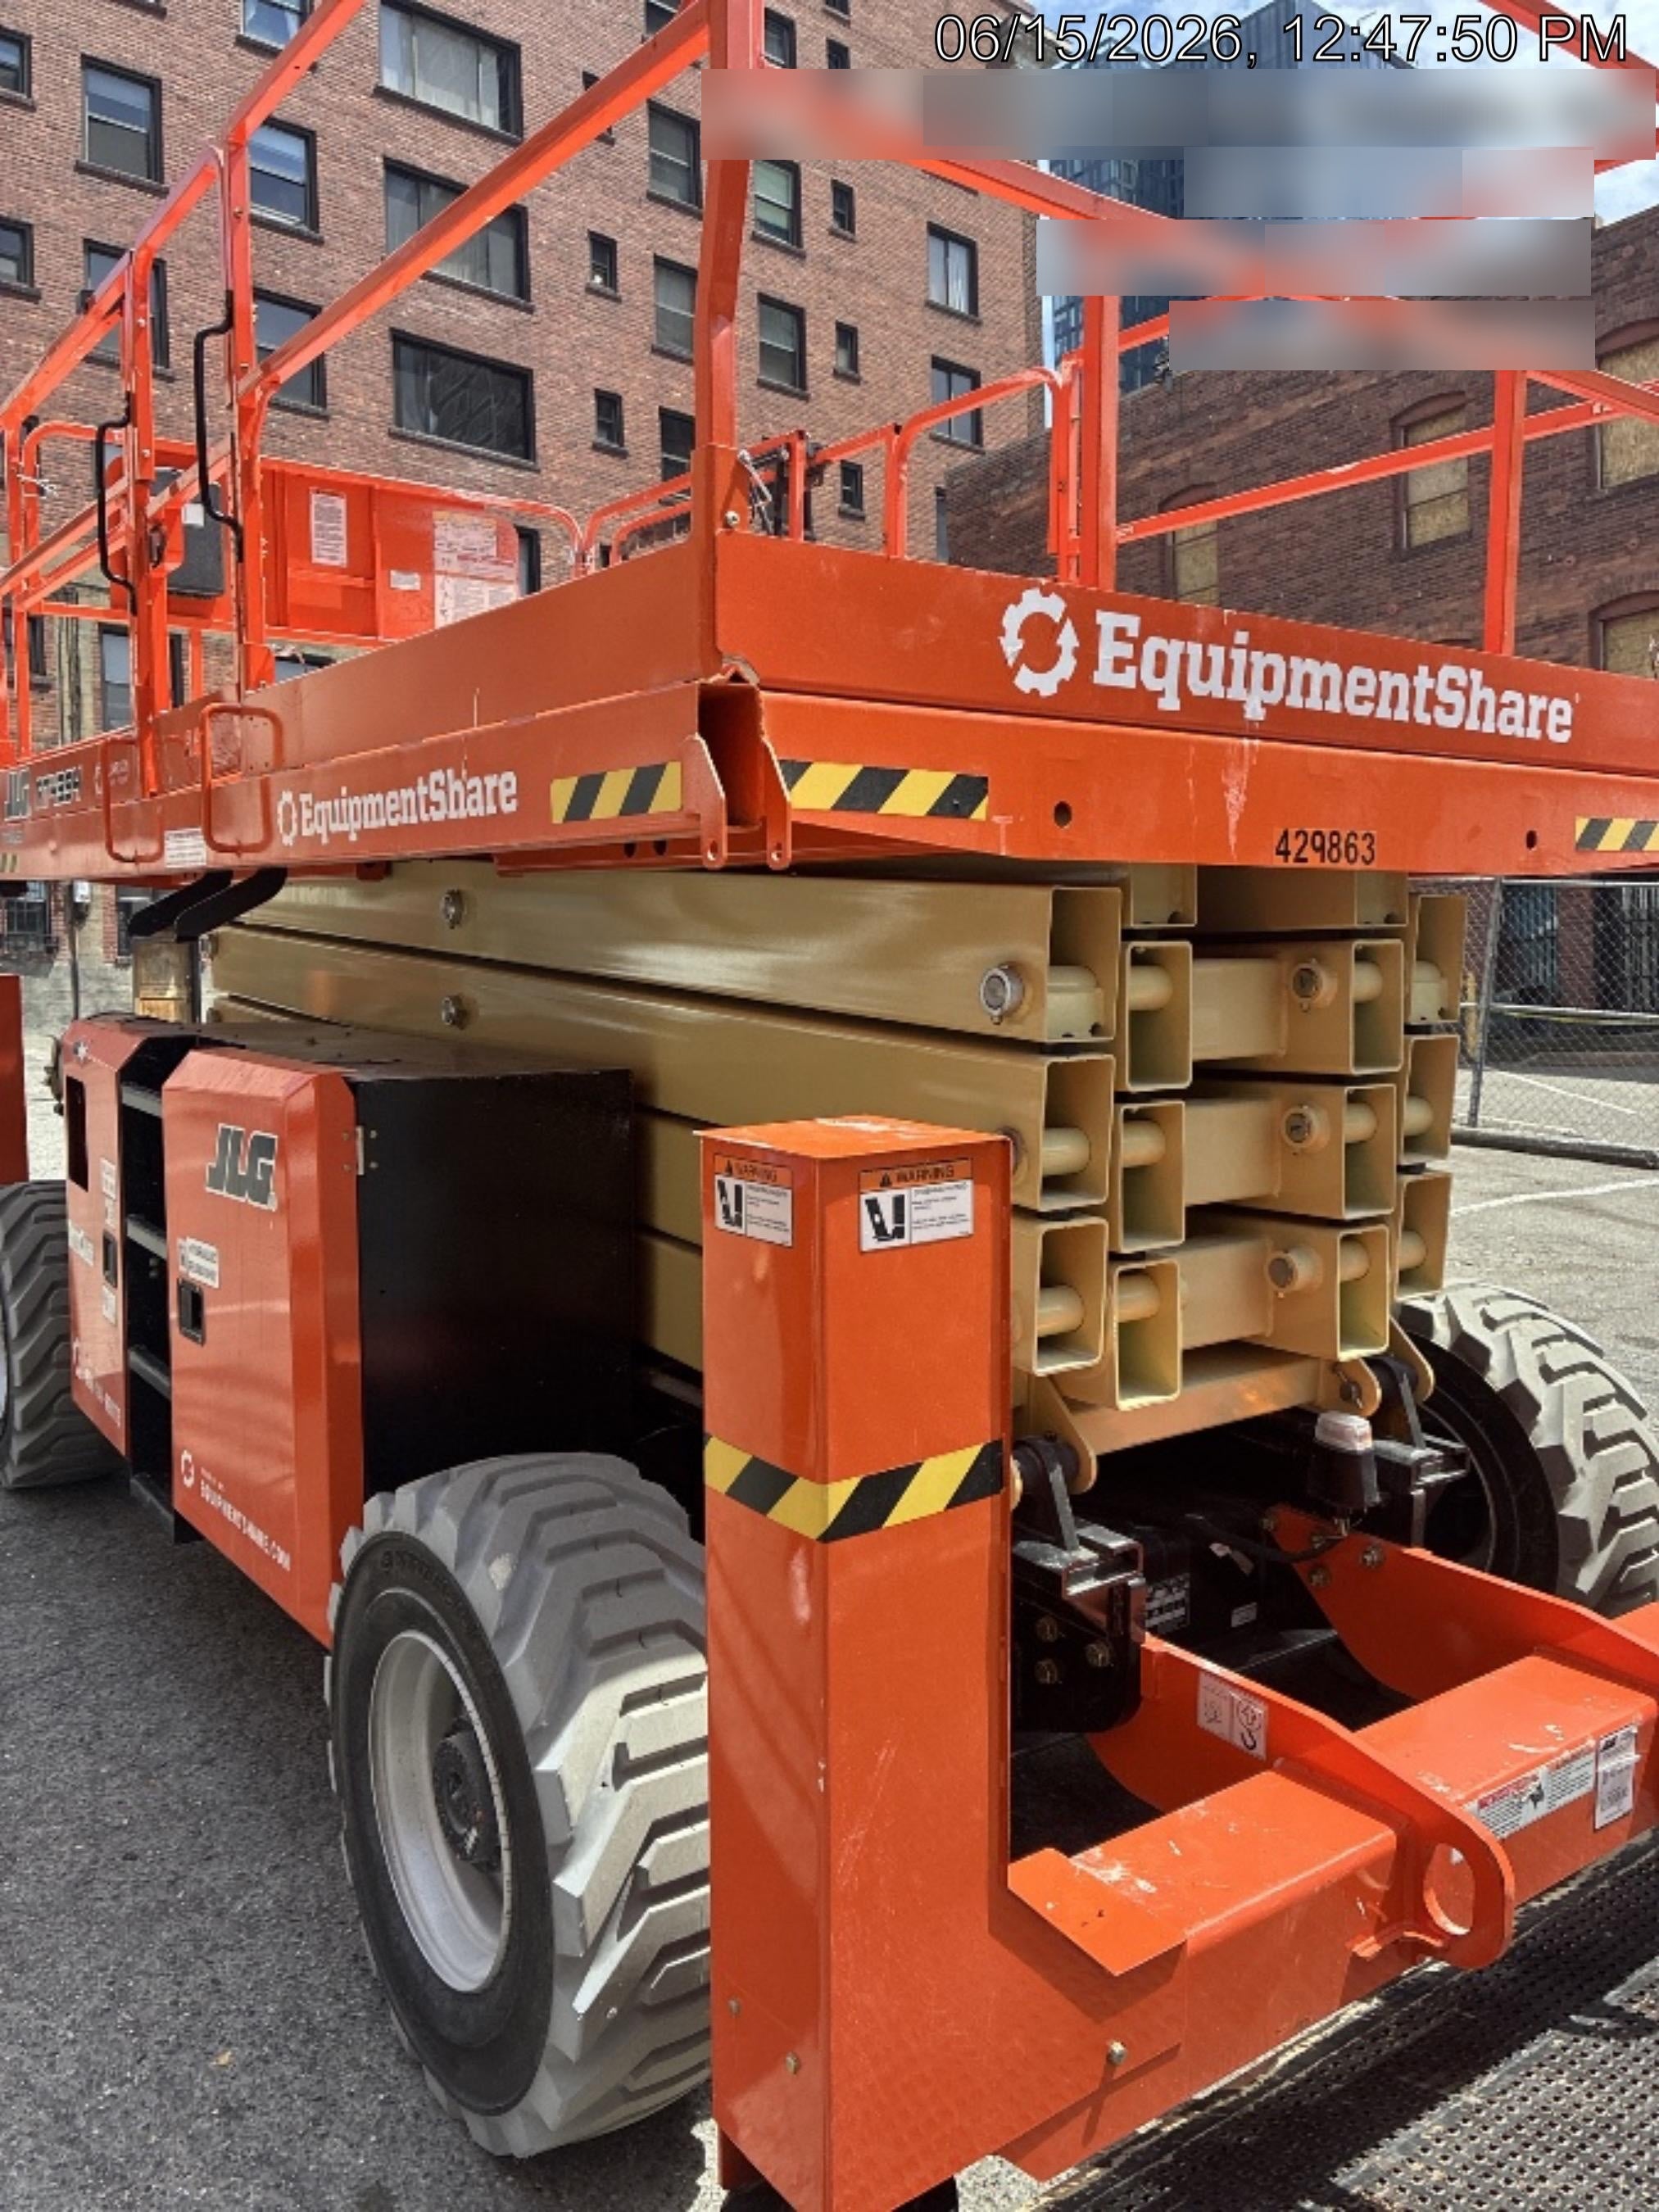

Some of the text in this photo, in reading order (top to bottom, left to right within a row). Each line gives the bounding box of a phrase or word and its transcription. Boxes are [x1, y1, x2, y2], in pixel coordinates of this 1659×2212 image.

[1093, 608, 1574, 745] EquipmentShare
[299, 768, 518, 845] EquipmentShare
[1275, 827, 1376, 864] 429863
[206, 1122, 279, 1211] JLG
